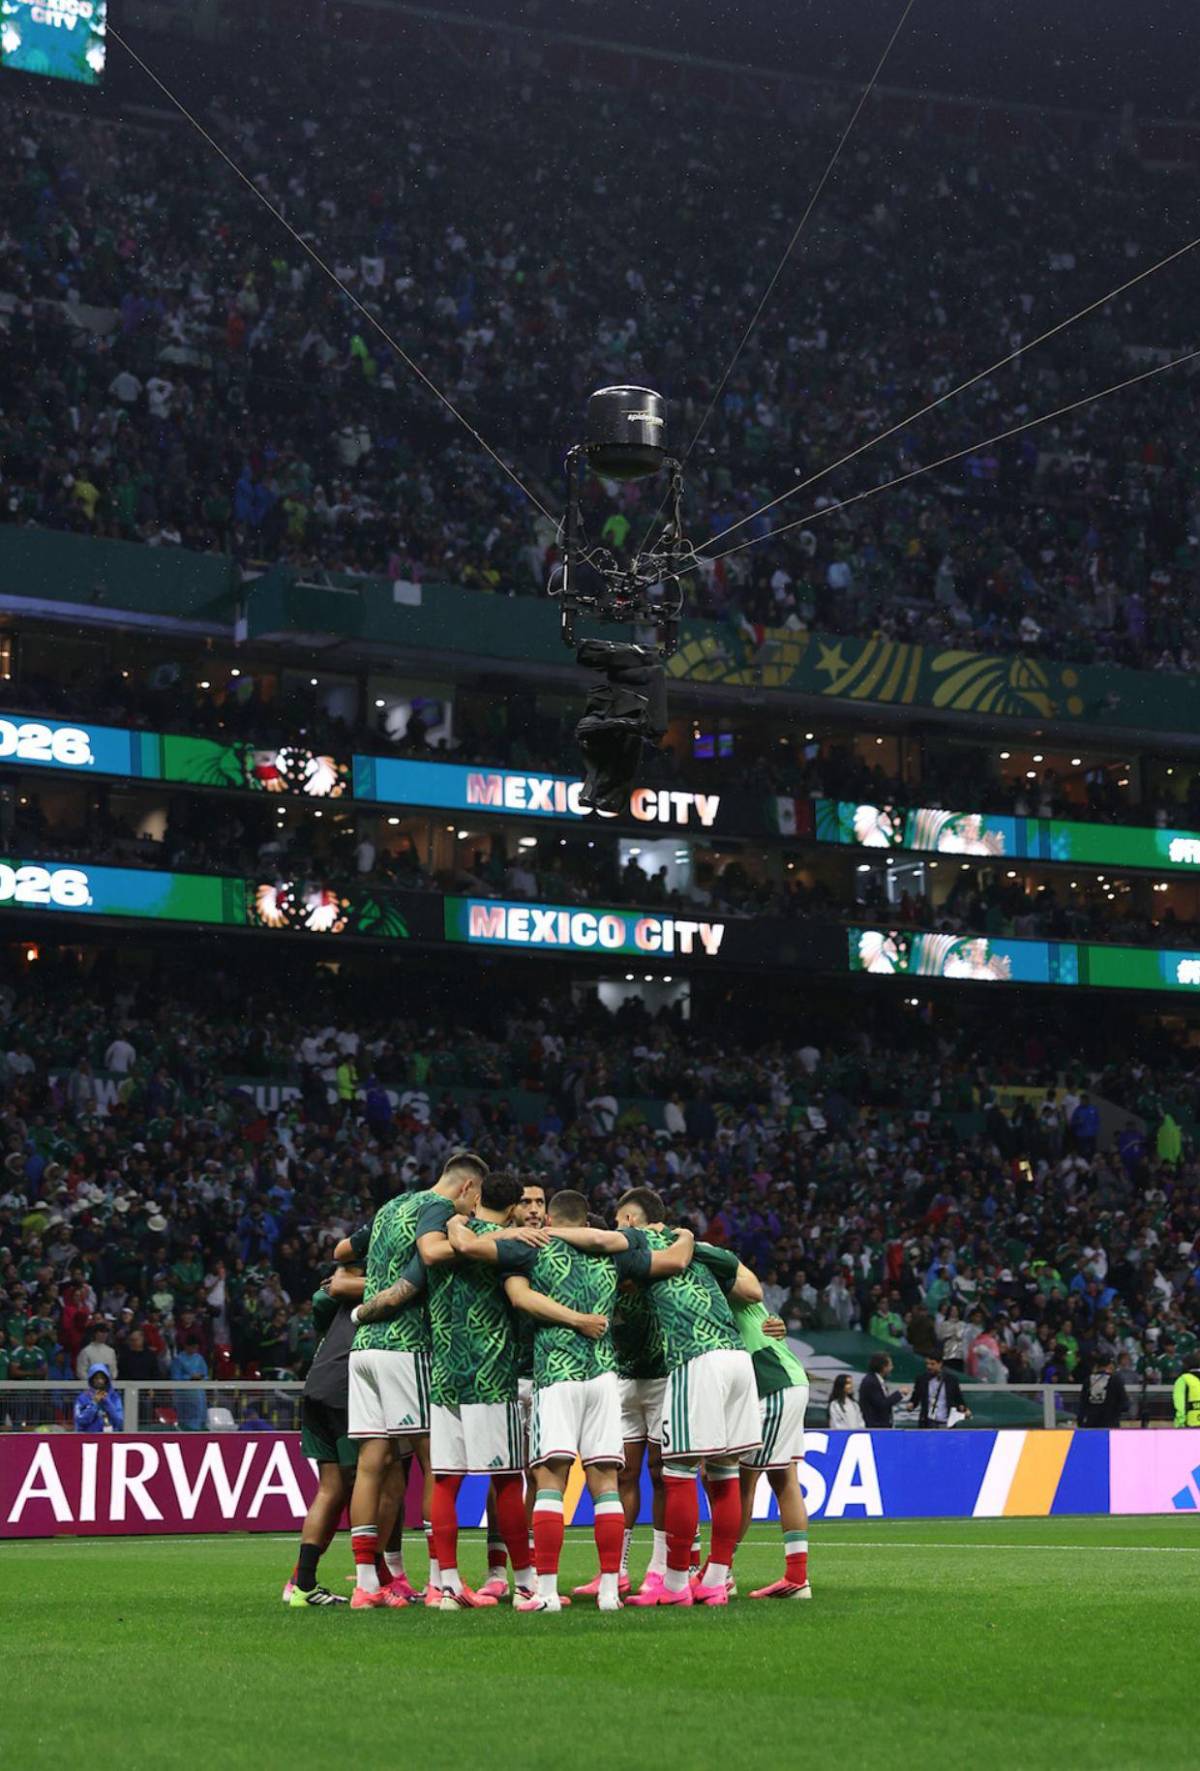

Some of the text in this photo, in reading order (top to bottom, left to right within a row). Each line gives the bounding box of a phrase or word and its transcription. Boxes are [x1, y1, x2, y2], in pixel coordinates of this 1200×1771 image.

[31, 6, 78, 30] CITY
[467, 773, 720, 827] MEXIC CITY
[469, 906, 725, 955] MEXICO CITY
[7, 1440, 320, 1523] AIRWA
[703, 1432, 884, 1519] ISA
